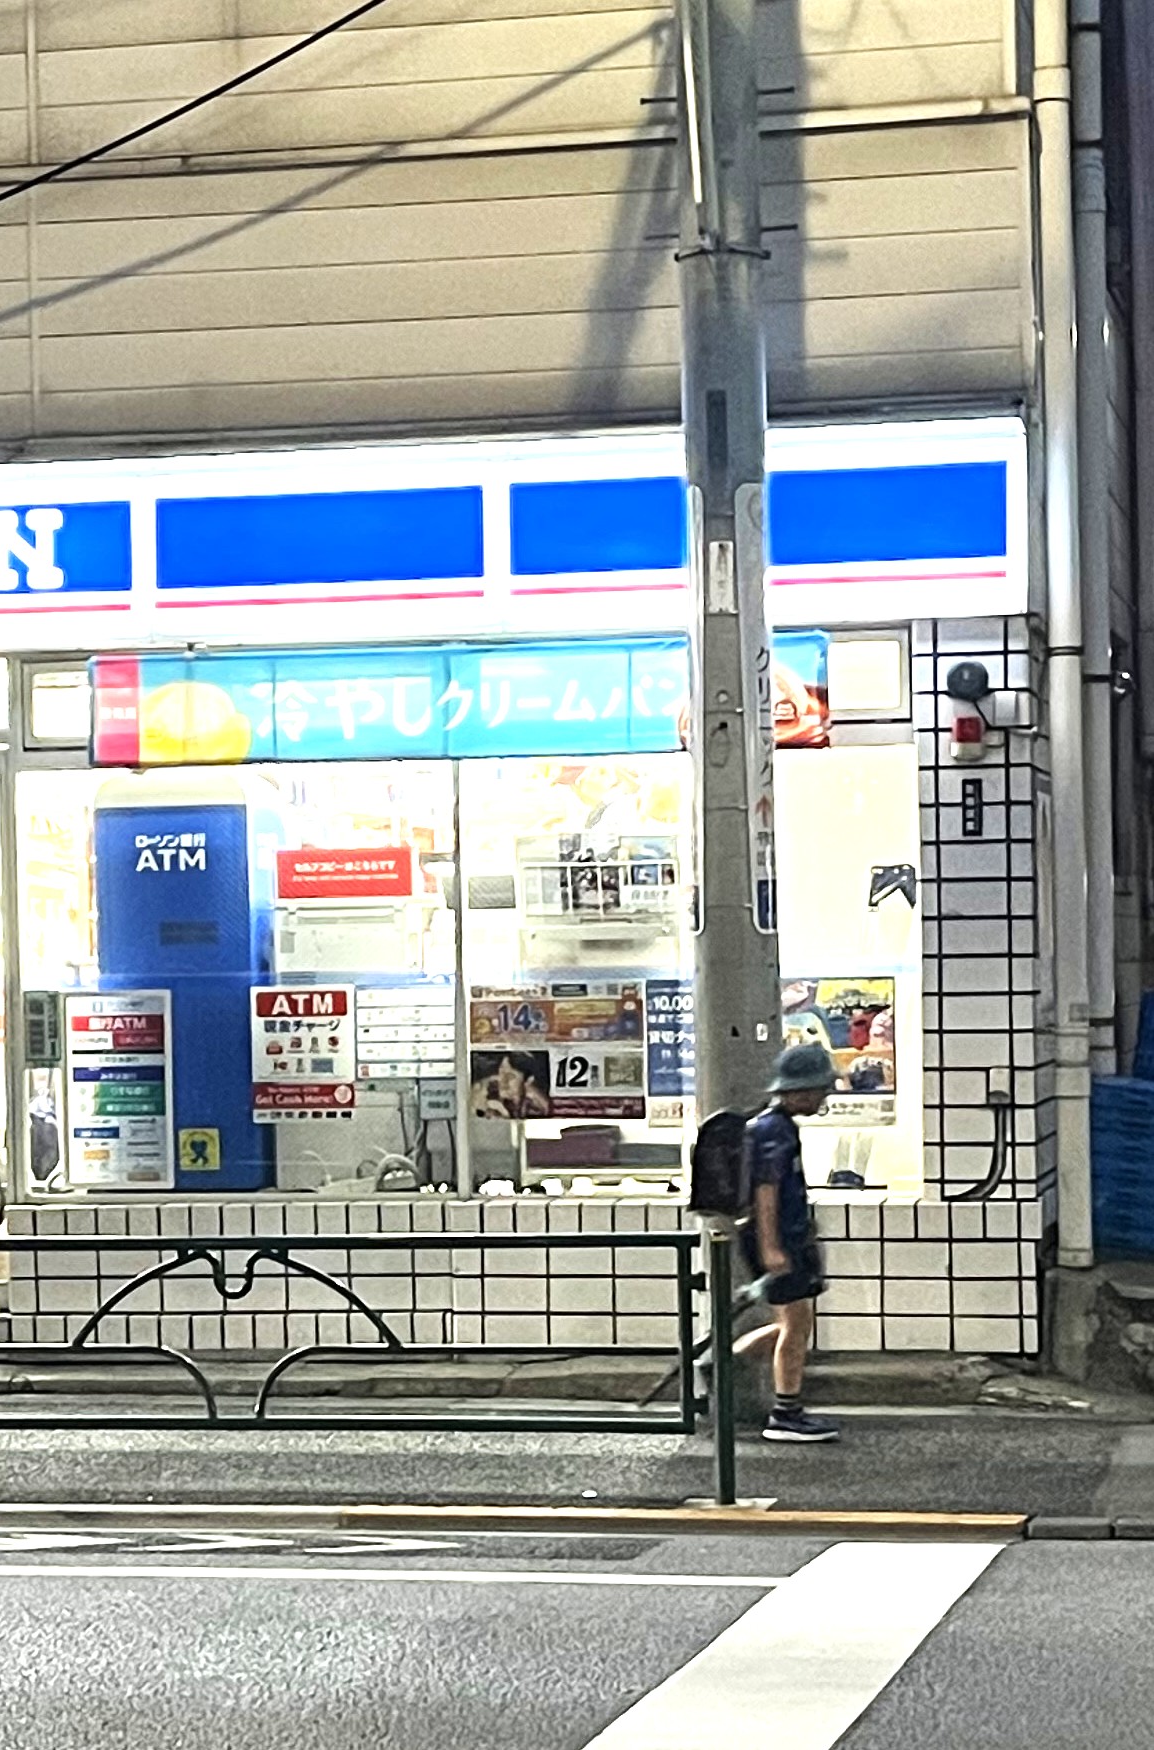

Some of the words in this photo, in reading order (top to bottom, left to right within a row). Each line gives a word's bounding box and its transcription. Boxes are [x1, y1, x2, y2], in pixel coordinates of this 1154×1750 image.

[135, 848, 206, 872] ATM
[271, 993, 334, 1015] ATM
[497, 1003, 532, 1032] 14
[555, 1056, 589, 1087] 12
